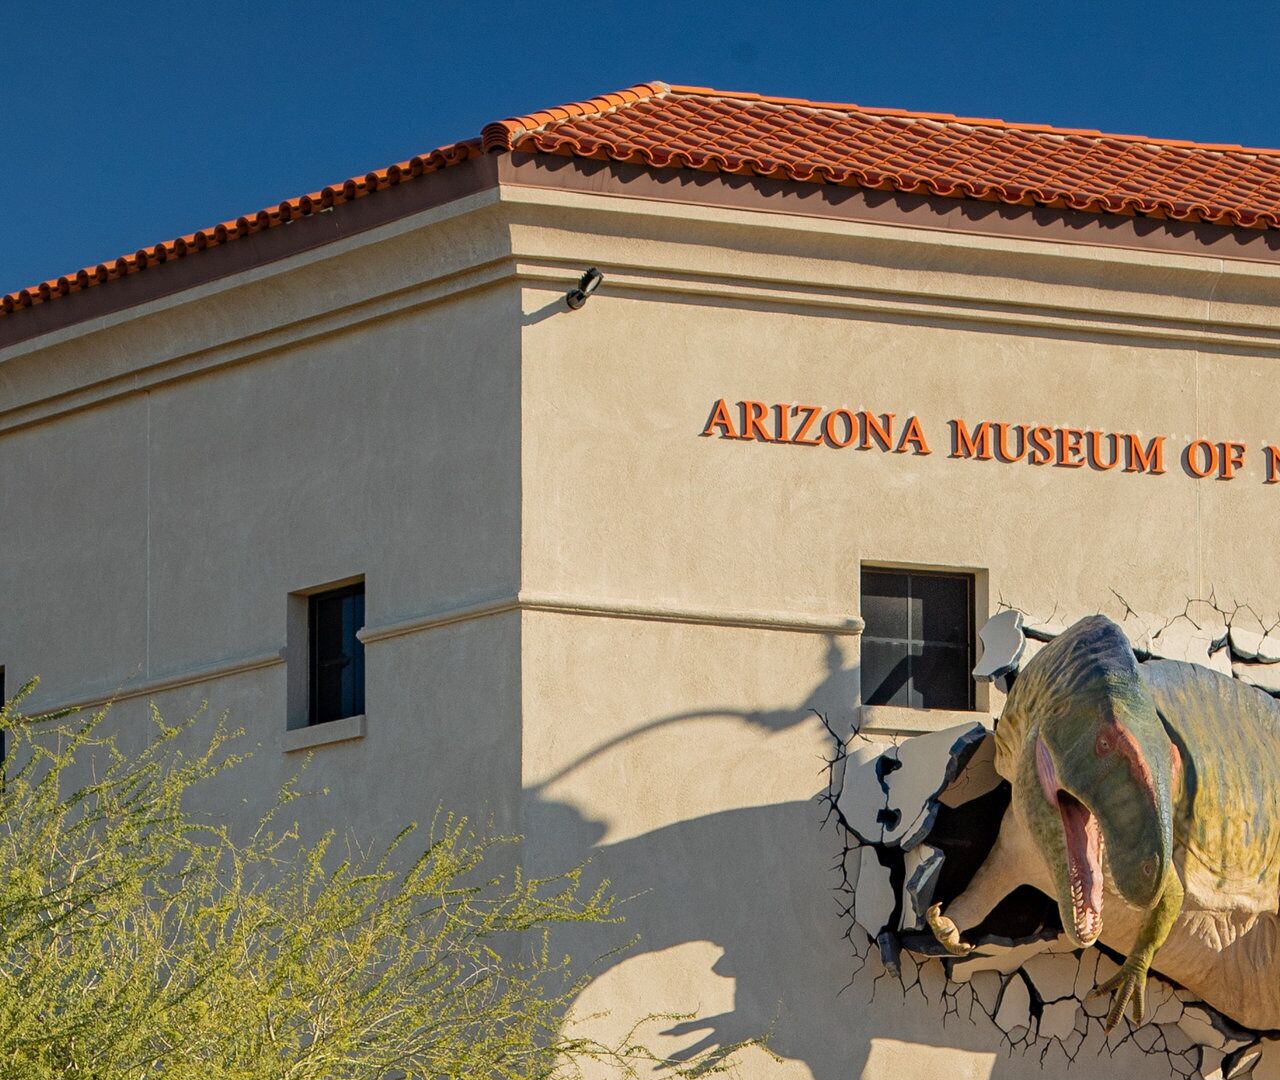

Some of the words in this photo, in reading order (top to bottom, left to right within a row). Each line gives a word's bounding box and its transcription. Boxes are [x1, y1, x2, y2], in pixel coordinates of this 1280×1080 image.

[701, 398, 932, 454] ARIZONA
[951, 418, 1167, 474] MUSEUM
[1184, 439, 1247, 480] OF
